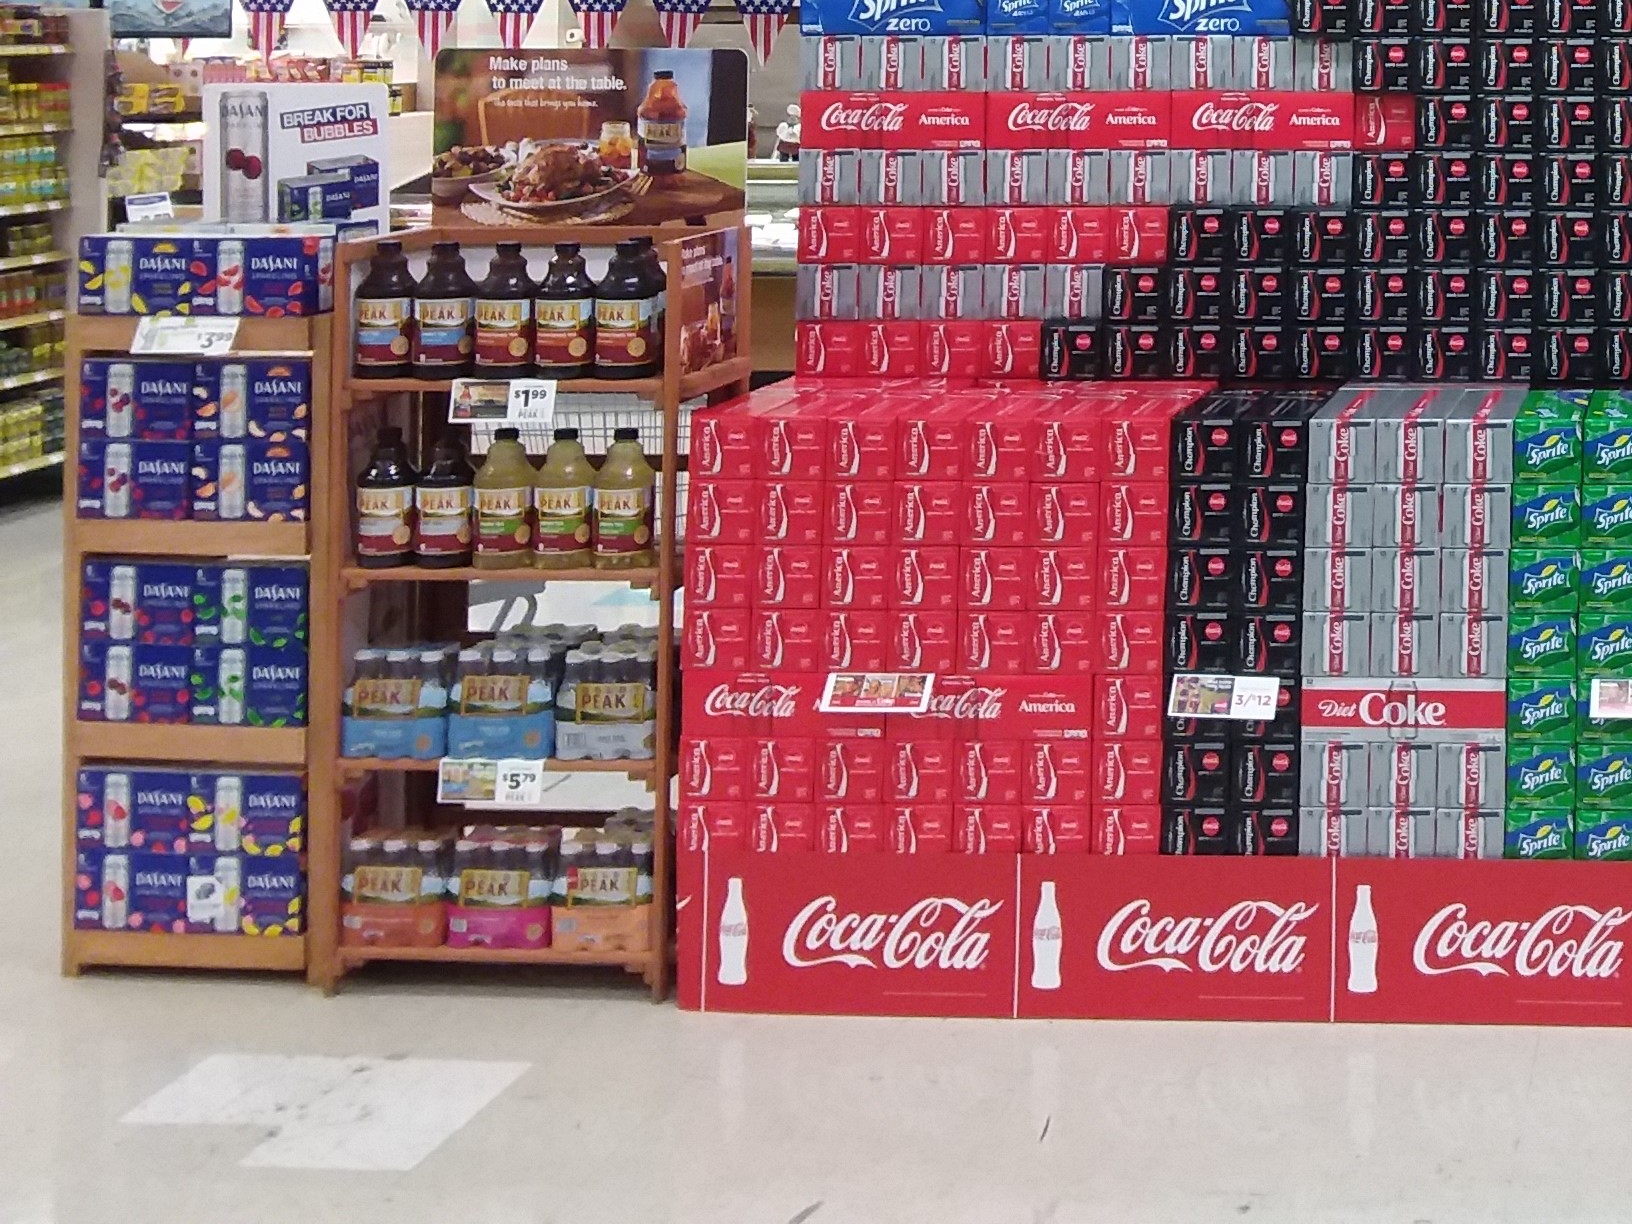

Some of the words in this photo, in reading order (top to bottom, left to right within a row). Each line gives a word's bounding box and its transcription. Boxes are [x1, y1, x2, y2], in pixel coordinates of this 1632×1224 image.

[886, 16, 931, 32] zero
[1195, 17, 1240, 32] zero
[490, 57, 528, 72] Make
[531, 57, 568, 73] plans
[492, 76, 505, 90] to
[509, 76, 544, 90] meet
[548, 76, 561, 90] at
[566, 76, 587, 90] the
[592, 76, 627, 91] table.
[283, 109, 334, 127] BREAK
[336, 105, 367, 121] FOR
[821, 103, 909, 131] Coca-Cola
[919, 112, 970, 126] America
[1008, 103, 1095, 131] Coca-Cola
[1105, 113, 1156, 126] America
[1192, 103, 1279, 131] Coca-Cola
[1289, 113, 1340, 126] America
[303, 120, 374, 143] BUBBLES
[139, 257, 186, 272] DASANI
[252, 257, 298, 272] DASANI
[141, 380, 188, 396] DASANI
[255, 380, 303, 396] DASANI
[1184, 427, 1194, 472] Champion
[1337, 427, 1350, 462] Coke
[1528, 443, 1569, 466] Sprite
[143, 583, 190, 600] DASANI
[255, 584, 301, 601] DASANI
[582, 693, 626, 710] PEAK
[704, 682, 801, 718] Coca-Cola
[1019, 699, 1076, 714] America
[1318, 699, 1356, 718] Diet
[1359, 693, 1446, 726] Coke
[782, 895, 1004, 972] Coca-Cola
[1096, 899, 1318, 975] Coca-Cola
